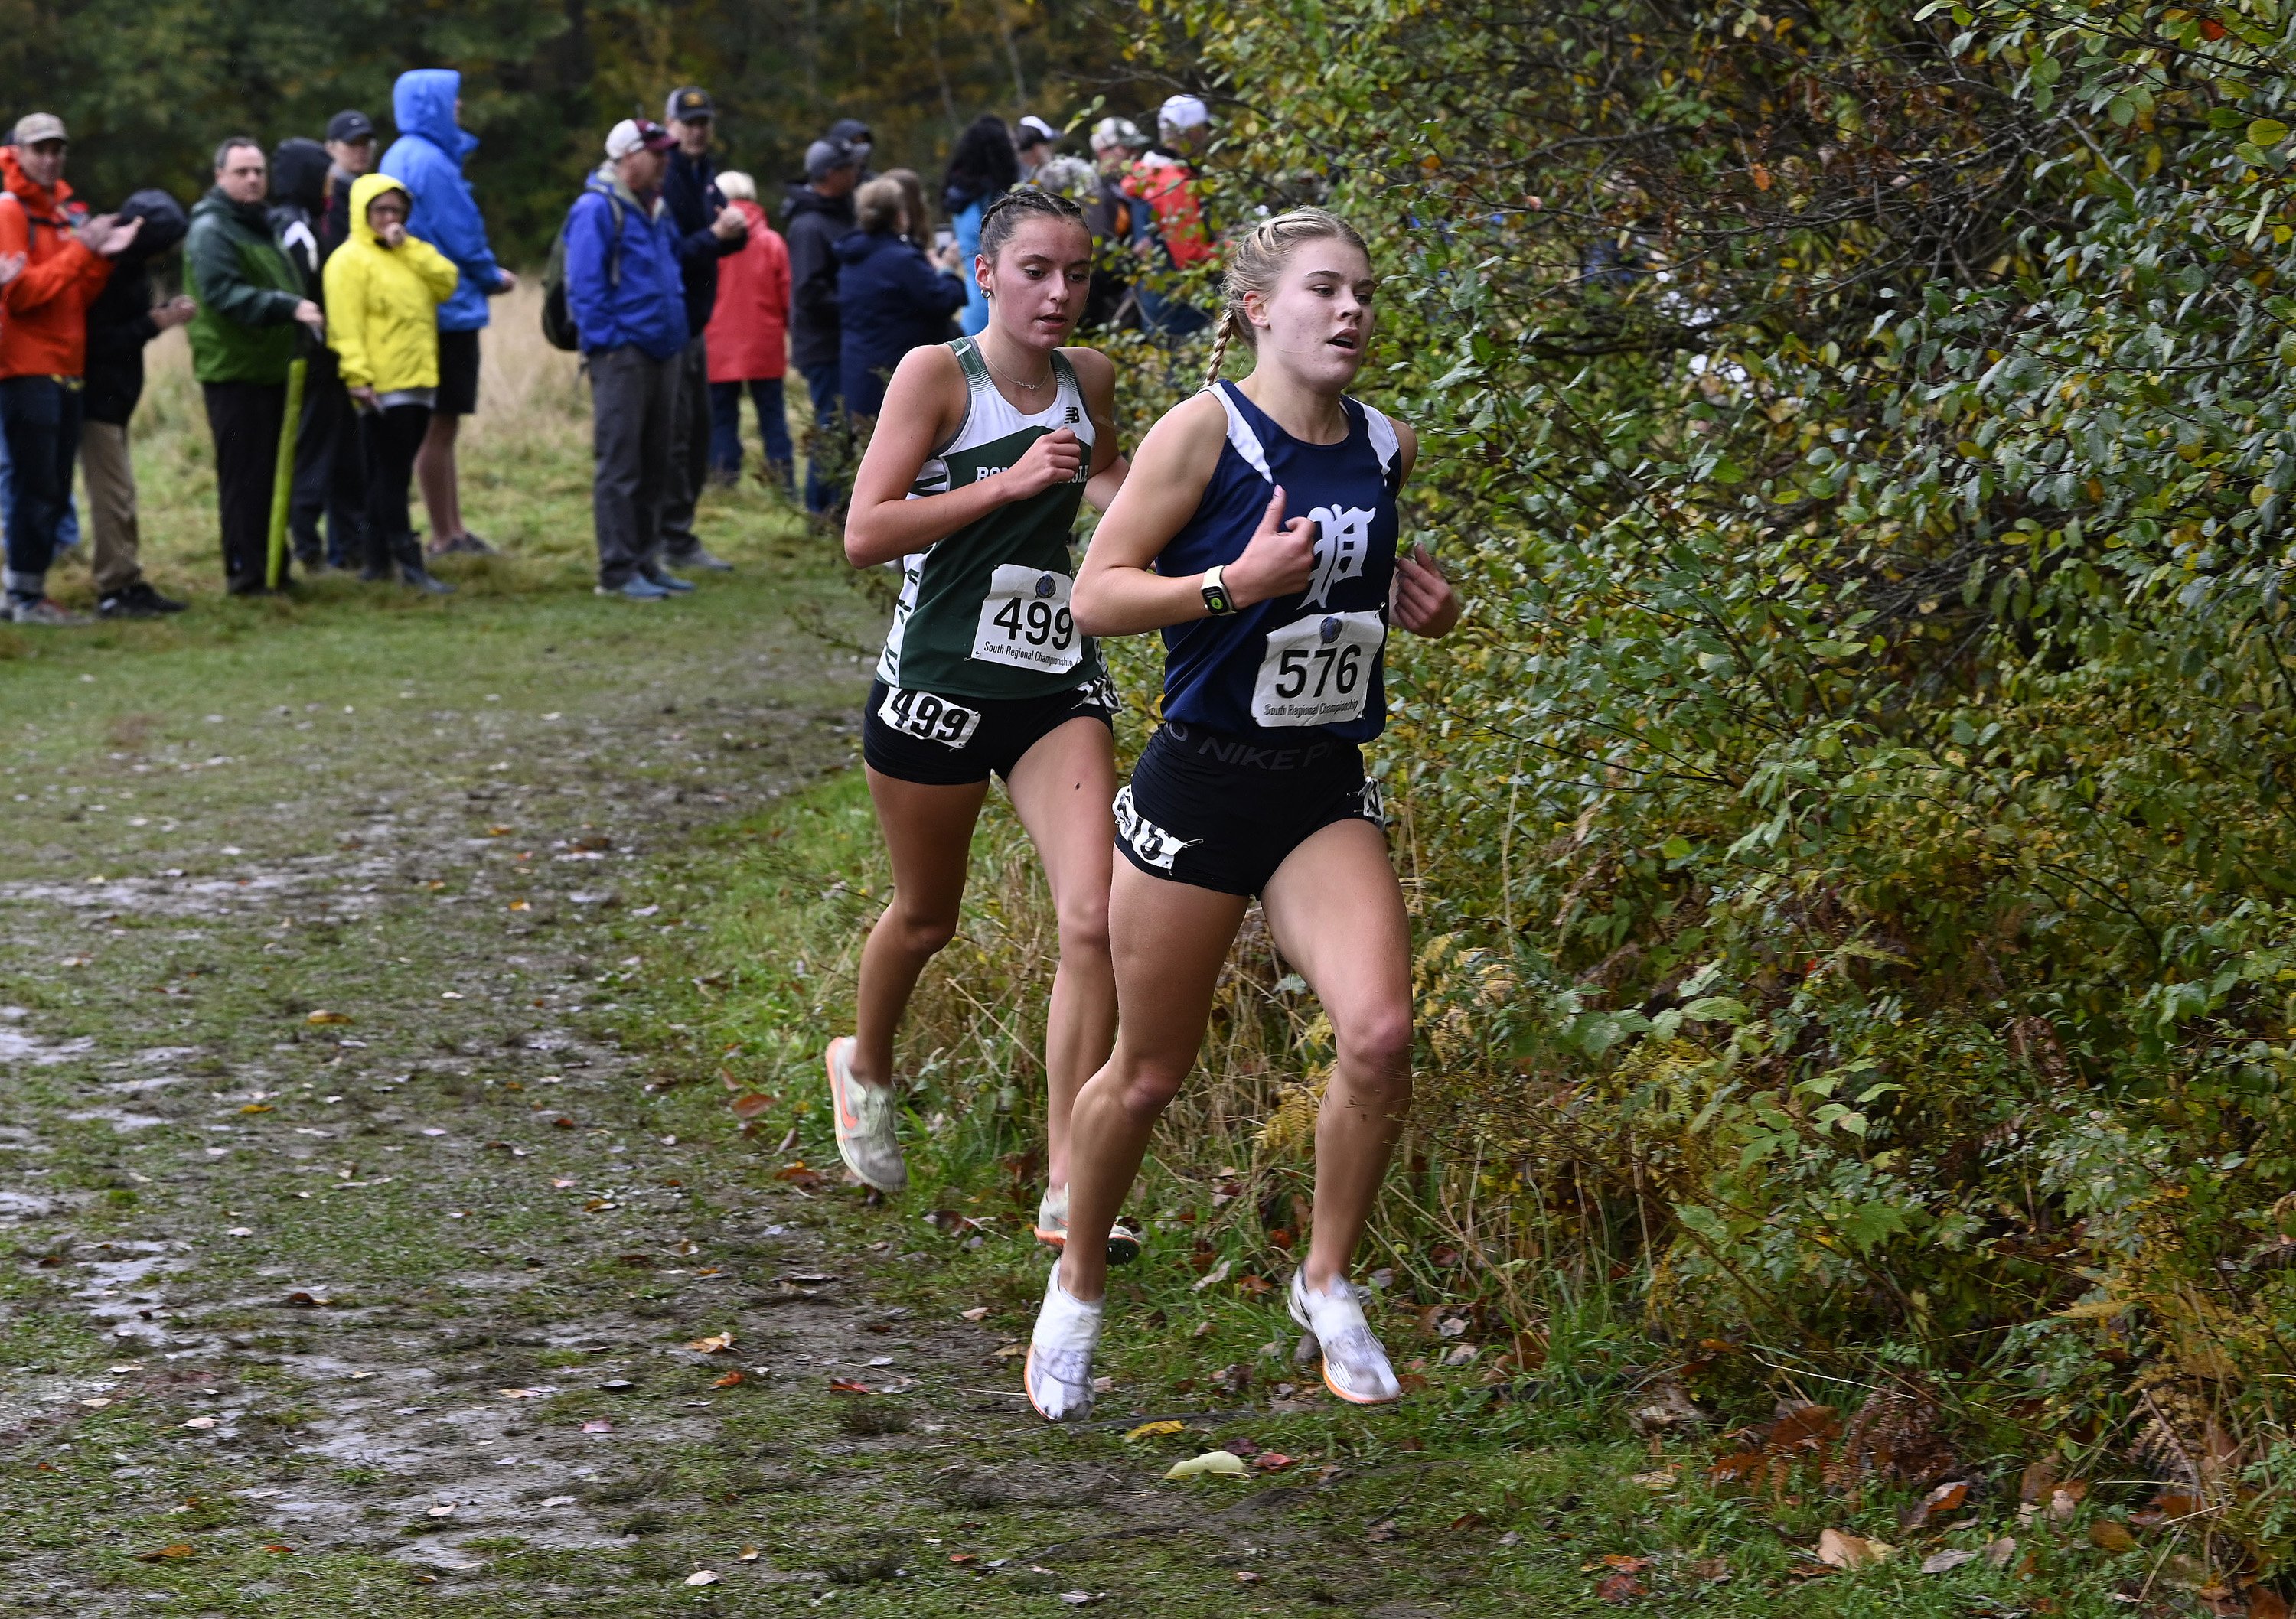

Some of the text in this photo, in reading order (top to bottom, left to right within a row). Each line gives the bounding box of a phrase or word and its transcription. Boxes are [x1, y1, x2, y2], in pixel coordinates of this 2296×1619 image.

[993, 597, 1074, 650] 499
[984, 641, 1004, 654] South
[1006, 646, 1034, 661] Regional
[1276, 644, 1362, 699] 576
[891, 689, 970, 741] 499
[1264, 698, 1358, 718] South Regional Championship
[1197, 736, 1301, 770] NIKE
